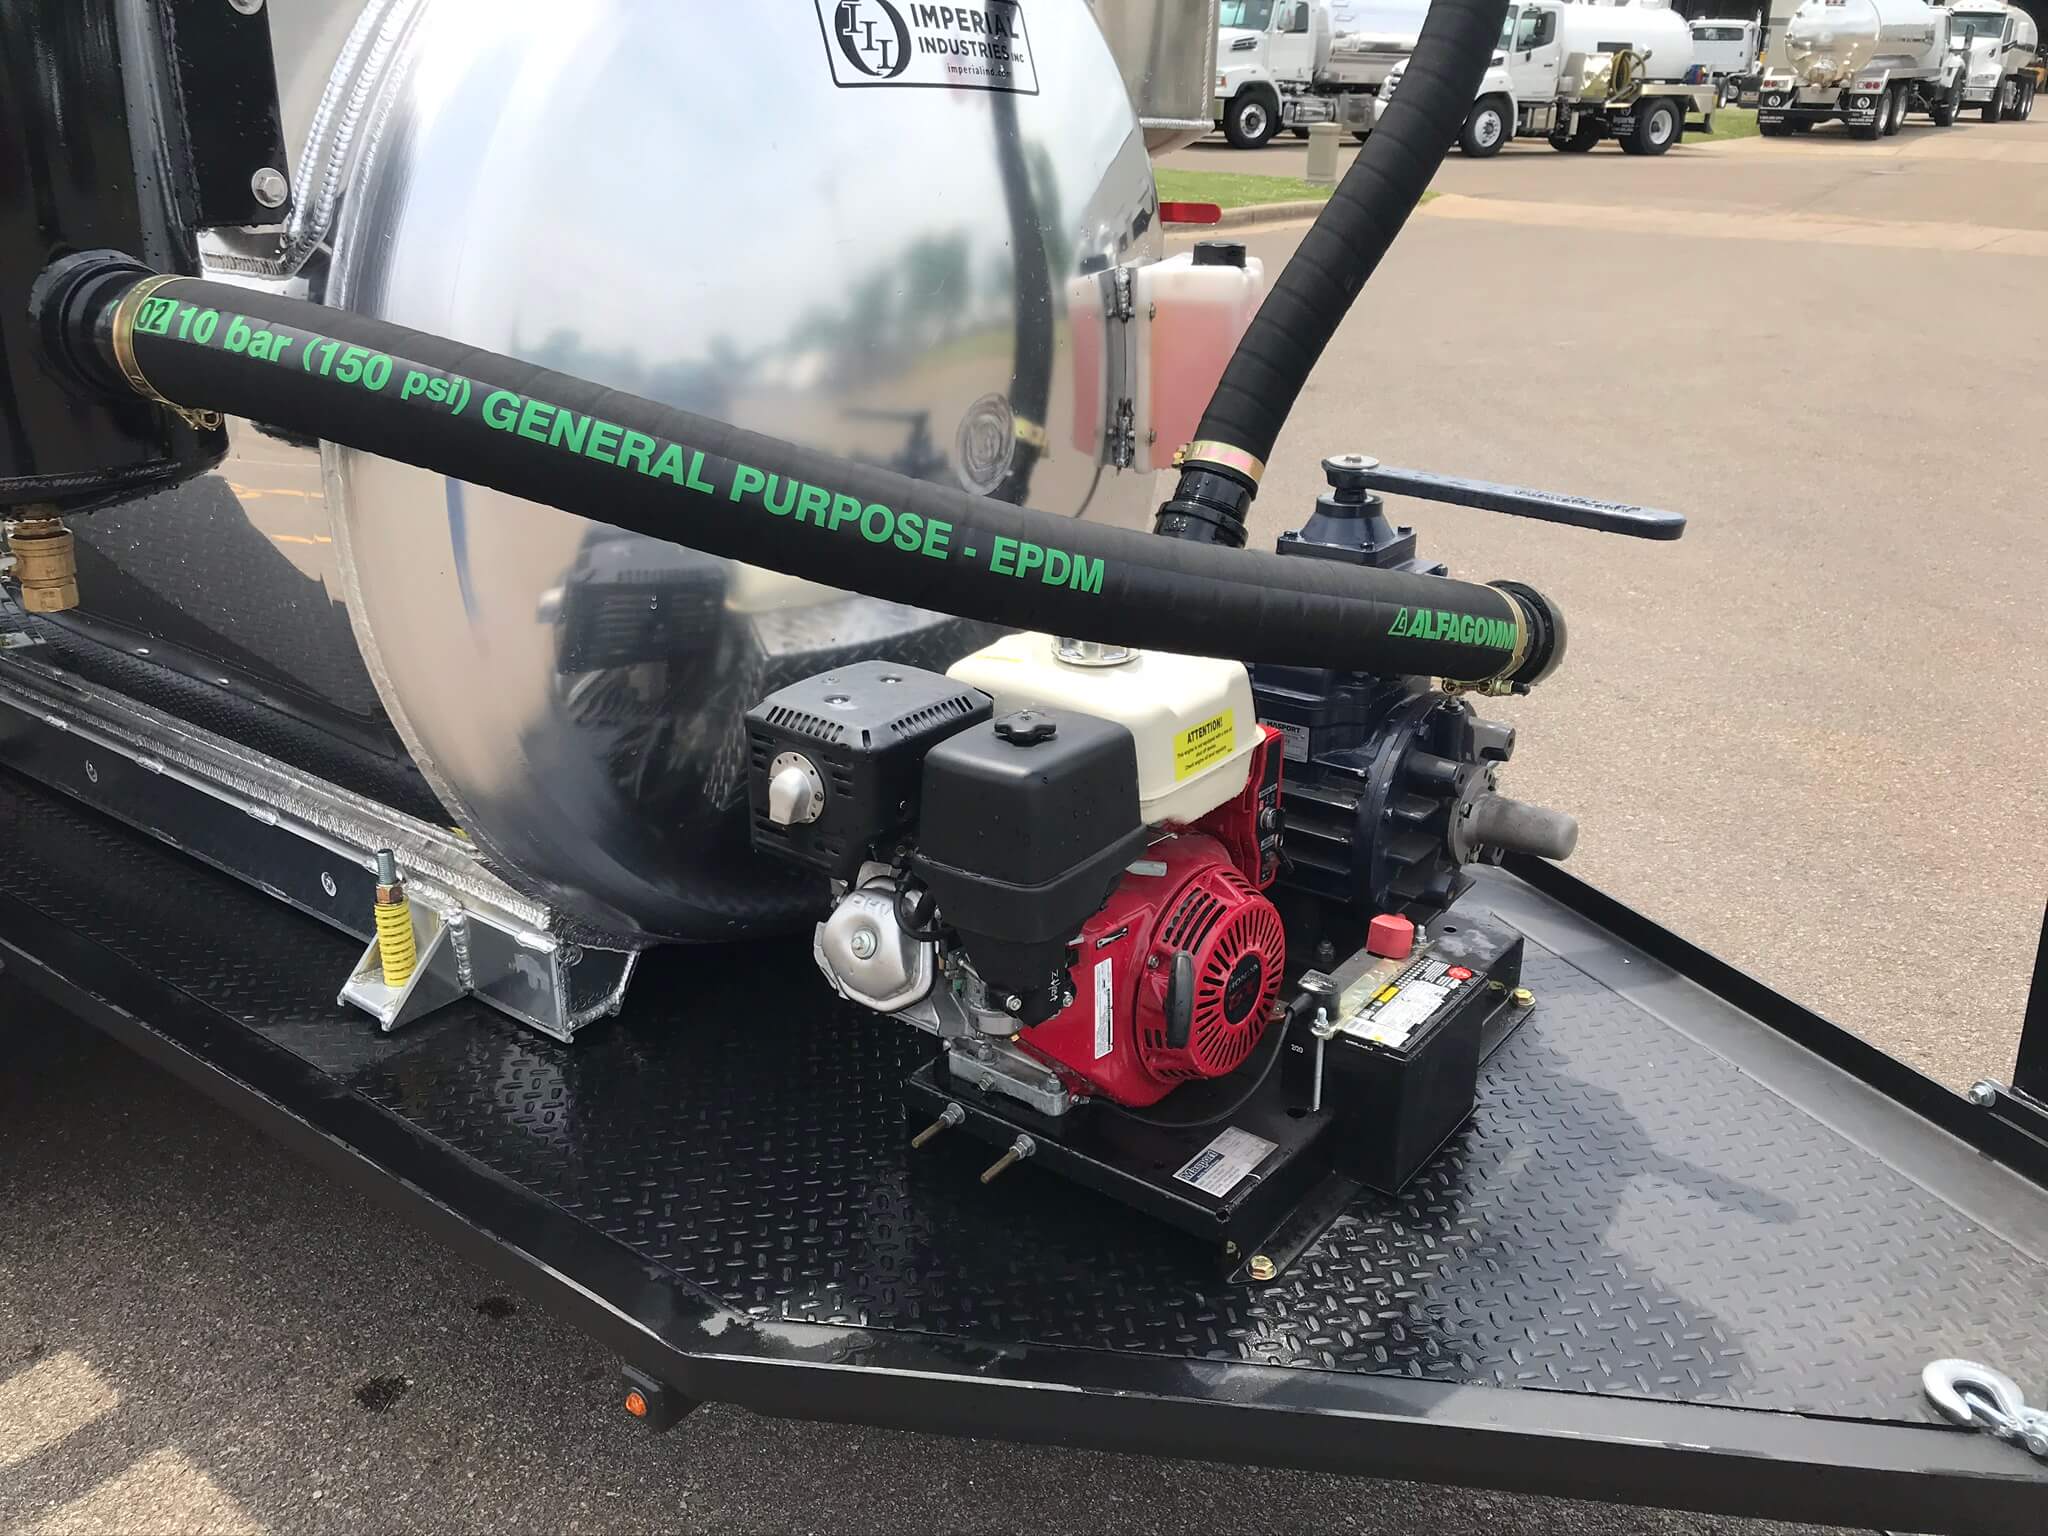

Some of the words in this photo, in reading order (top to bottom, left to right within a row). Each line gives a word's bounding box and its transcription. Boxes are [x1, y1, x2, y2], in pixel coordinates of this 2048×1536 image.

[910, 3, 1020, 40] IMPERIAL
[918, 36, 1010, 61] INDUSTRIES
[1011, 52, 1025, 63] INC
[136, 299, 170, 330] 02
[178, 306, 220, 344] 10
[223, 315, 294, 363] bar
[302, 336, 394, 392] (150
[400, 369, 473, 416] psi)
[482, 390, 715, 495] GENERAL
[728, 463, 954, 560] PURPOSE
[988, 535, 1105, 594] EPDM
[1187, 716, 1223, 745] ATTENTION!
[1266, 720, 1301, 734] MASPORT
[1179, 1149, 1220, 1181] Masport
